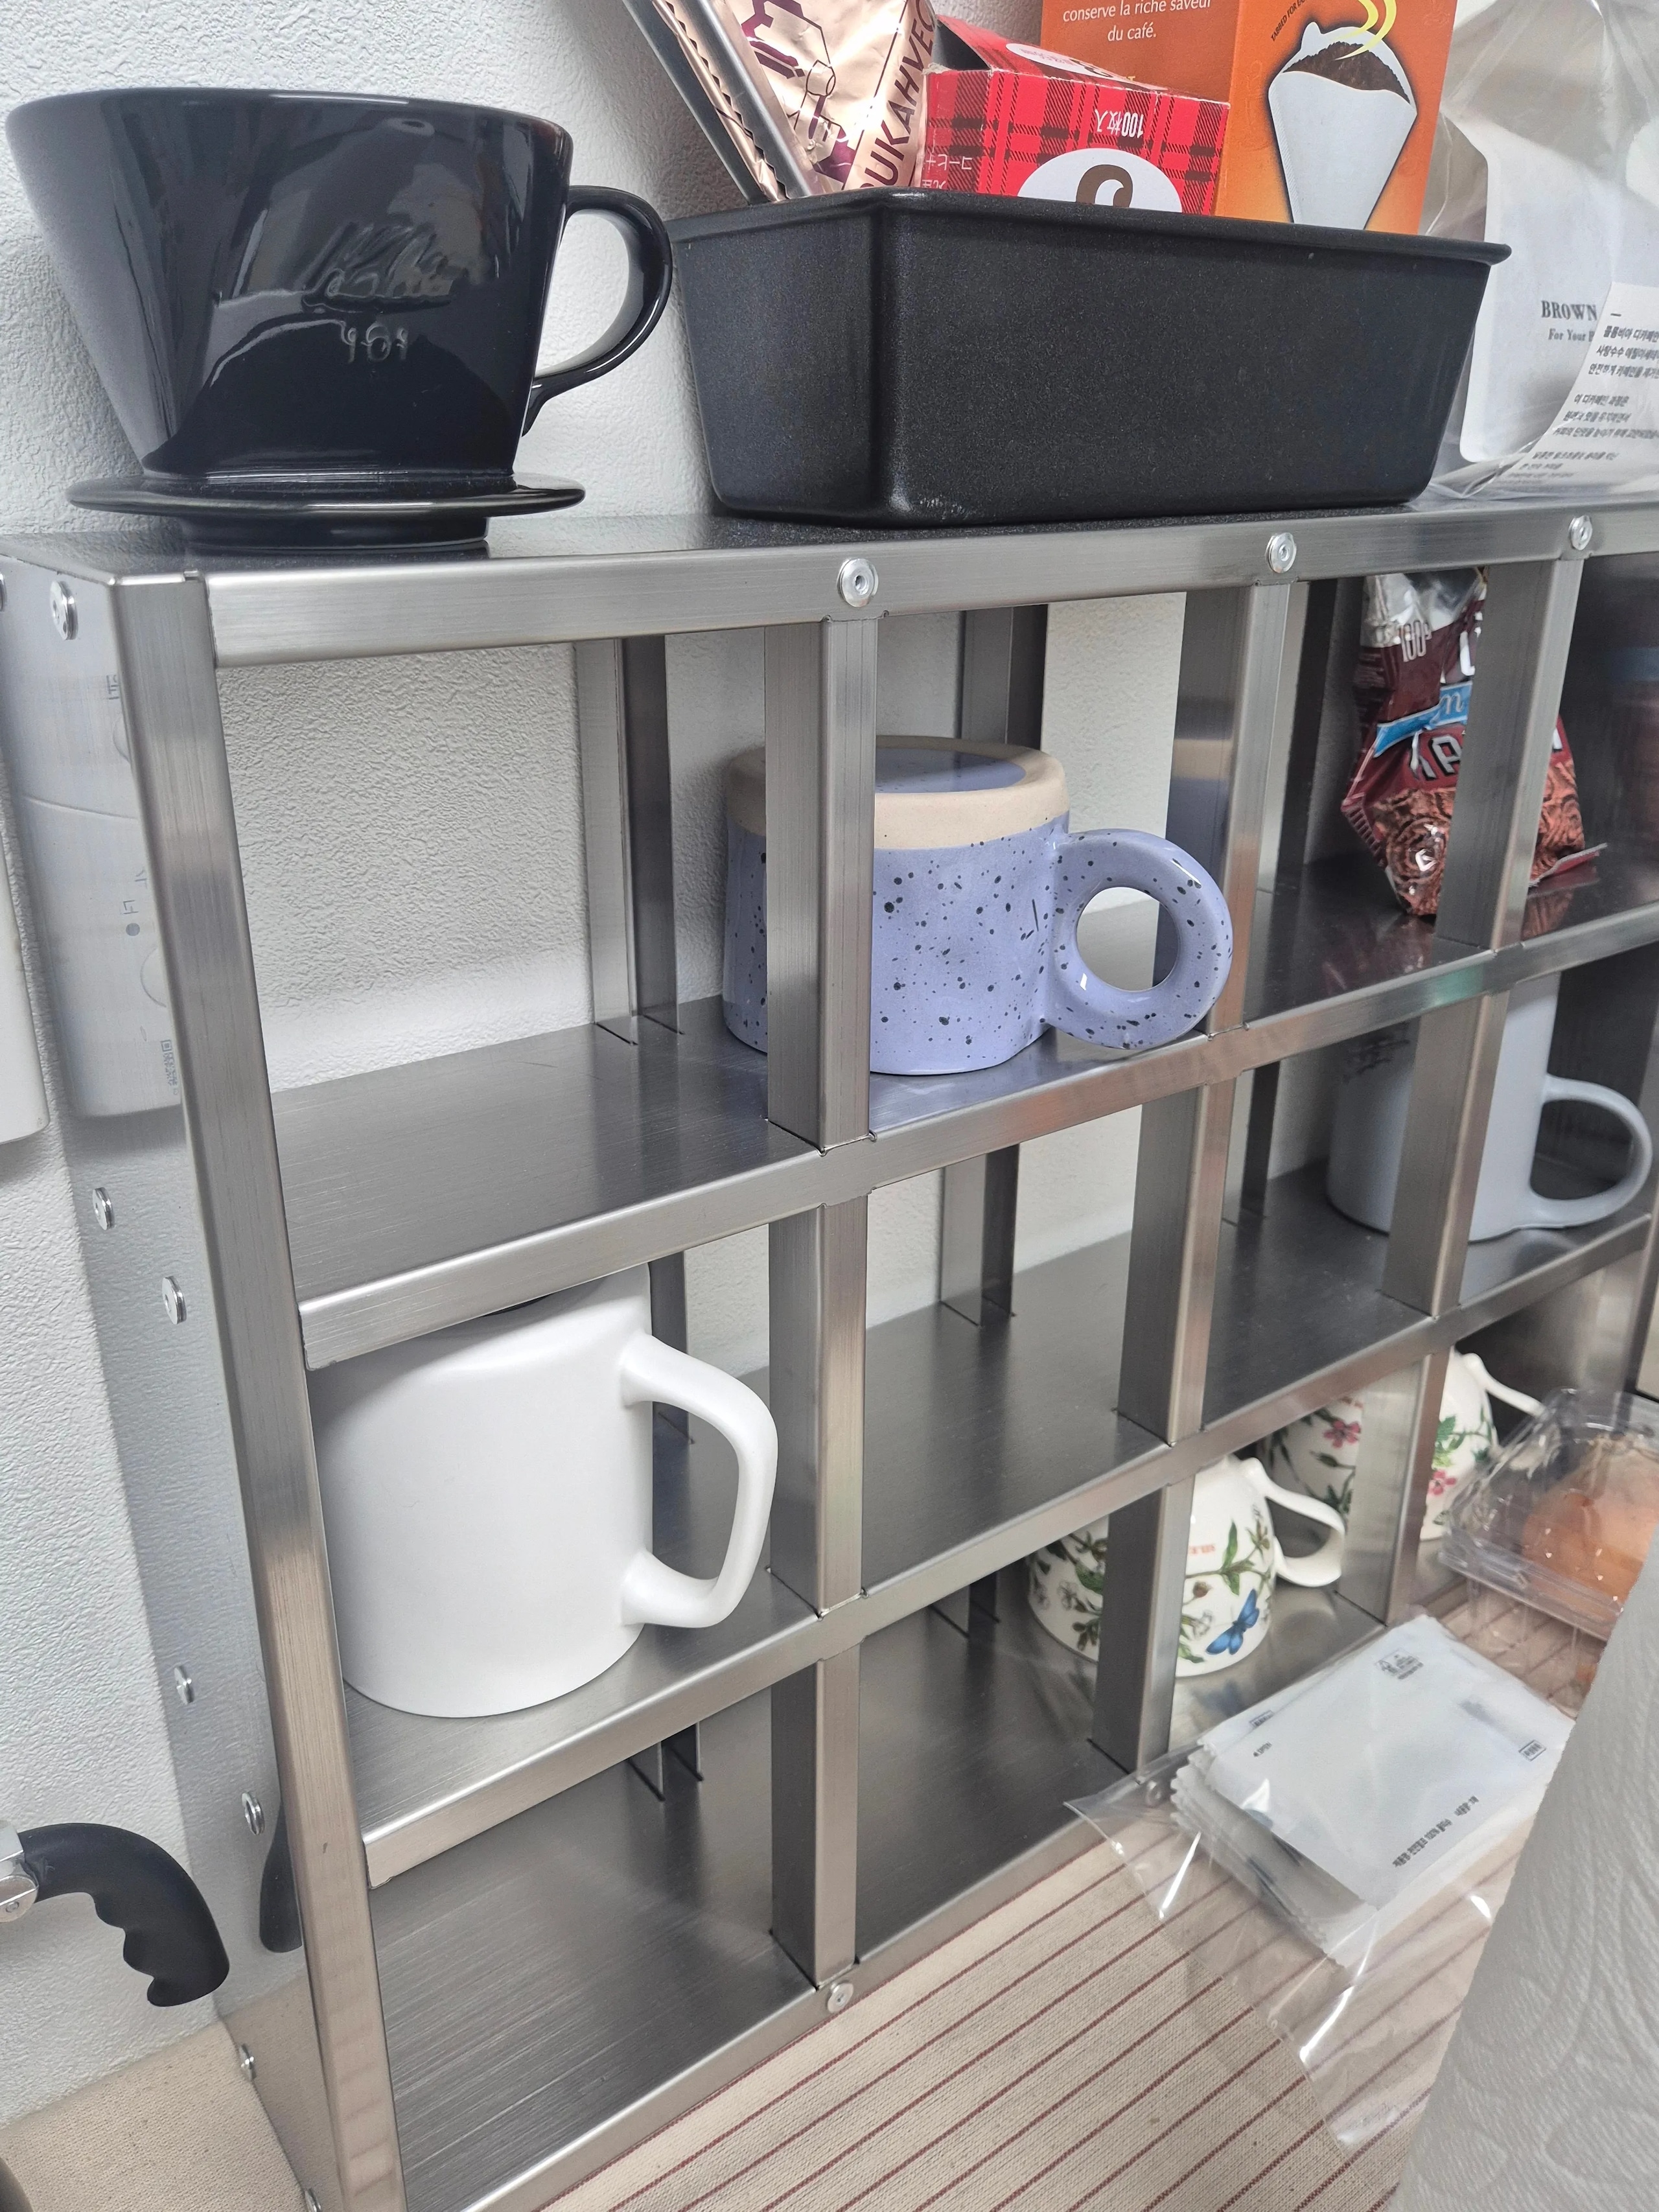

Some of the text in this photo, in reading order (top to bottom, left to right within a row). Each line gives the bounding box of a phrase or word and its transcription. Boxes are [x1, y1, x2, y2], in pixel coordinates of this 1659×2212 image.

[1063, 5, 1116, 22] conserve
[1120, 0, 1131, 16] la
[1135, 0, 1166, 14] riche
[1108, 22, 1157, 41] du café.
[1271, 3, 1297, 41] TABBED FOR
[1095, 109, 1144, 139] 100枚入
[1541, 300, 1597, 321] BROWN
[1548, 328, 1564, 340] For
[1567, 329, 1586, 342] Your
